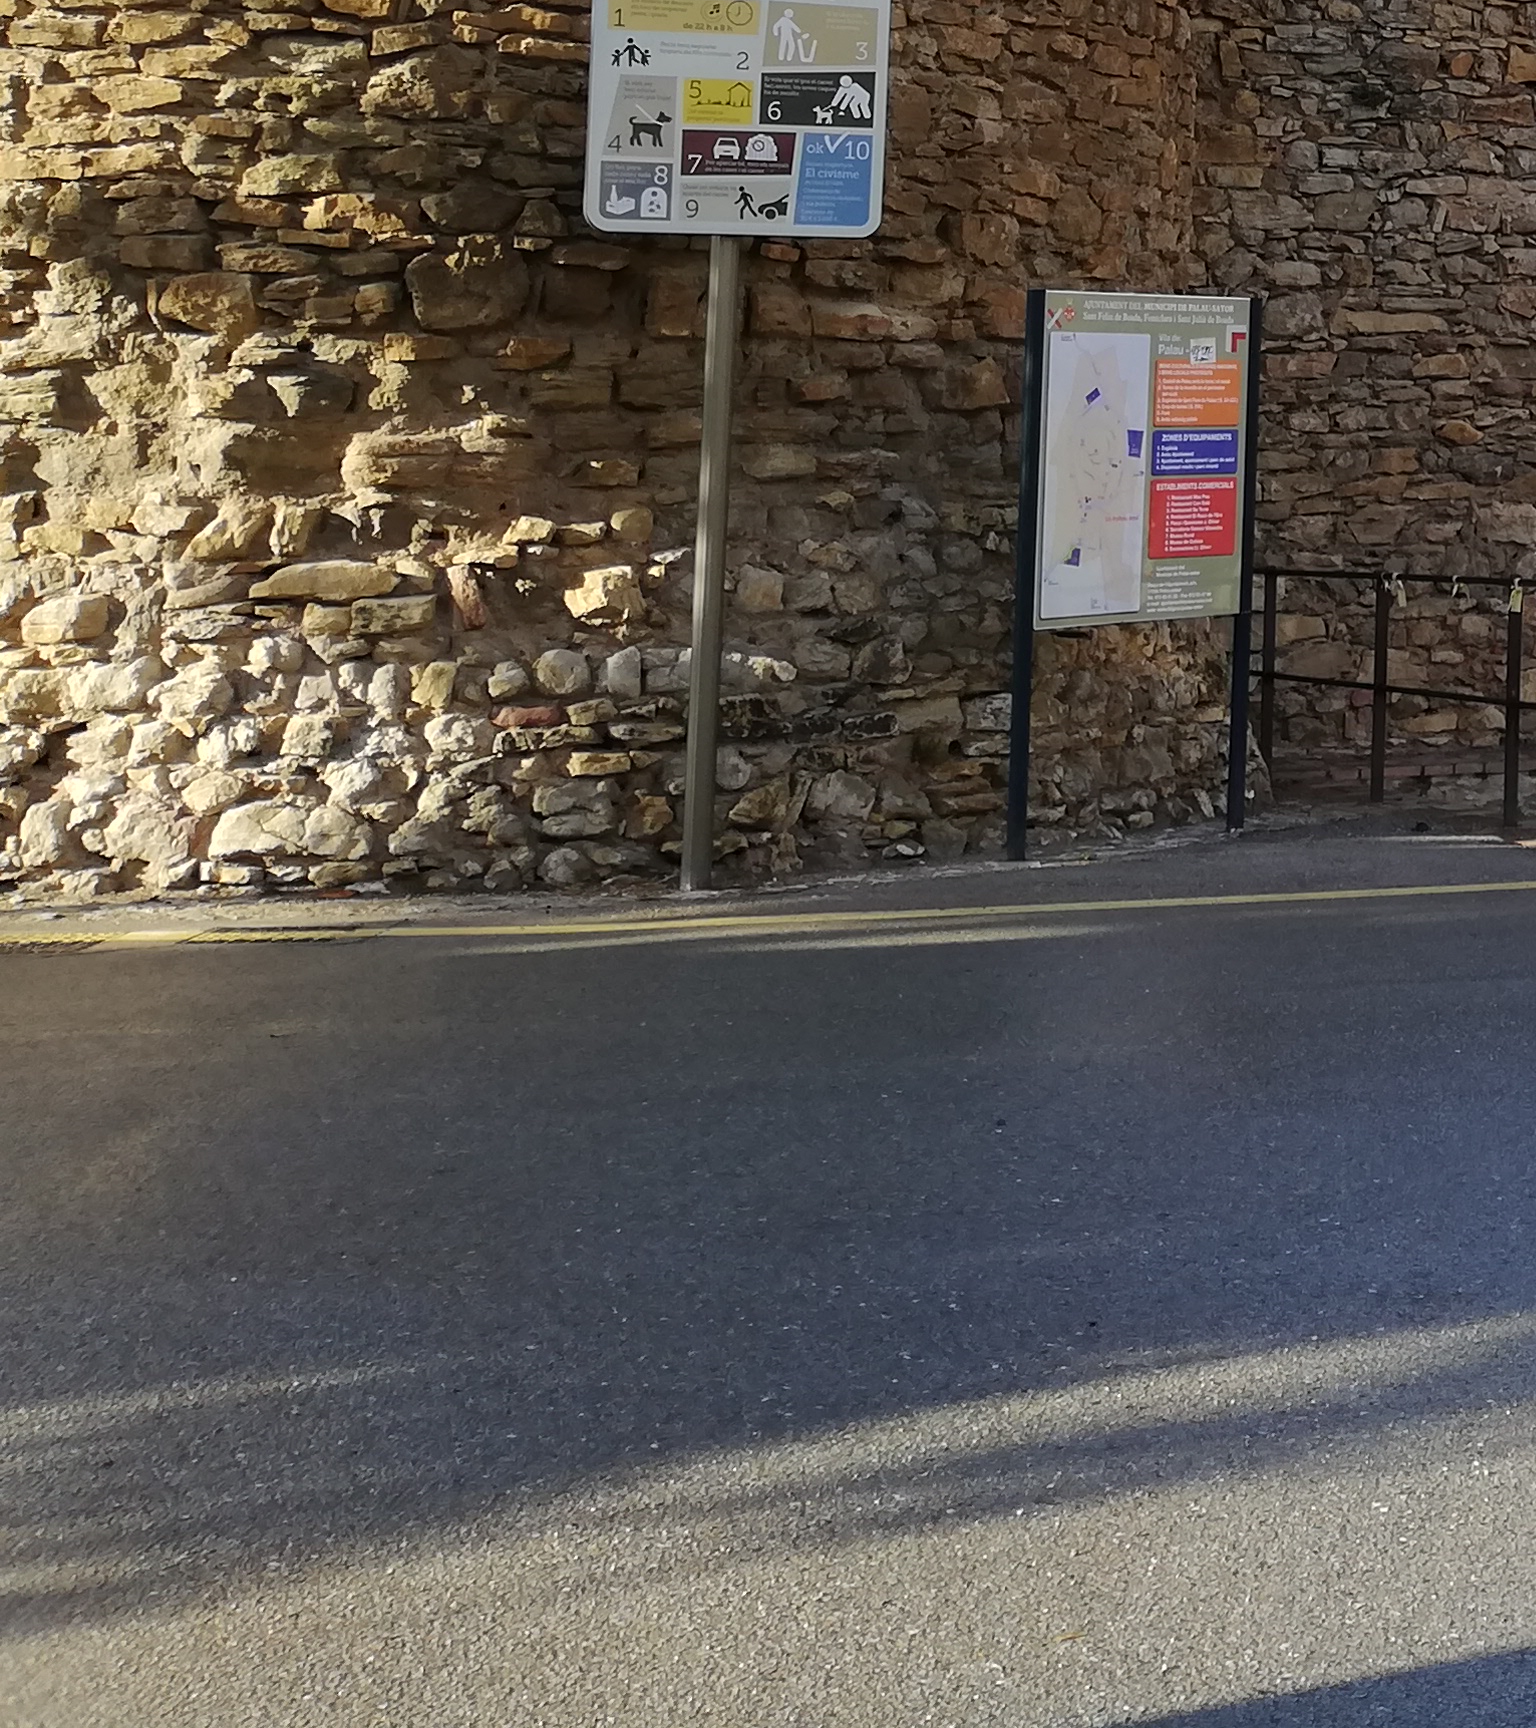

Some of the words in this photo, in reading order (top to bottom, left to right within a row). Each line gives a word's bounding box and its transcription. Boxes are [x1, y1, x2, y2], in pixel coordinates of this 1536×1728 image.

[613, 8, 626, 27] 1
[736, 51, 750, 70] 2
[856, 42, 868, 60] 3
[689, 80, 702, 98] 5
[768, 101, 781, 120] 6
[608, 134, 622, 152] 4
[806, 142, 824, 154] ok
[844, 140, 870, 160] 10
[687, 154, 703, 174] 7
[654, 165, 668, 186] 8
[805, 168, 816, 178] El
[817, 169, 860, 180] civisme
[685, 199, 699, 218] 9
